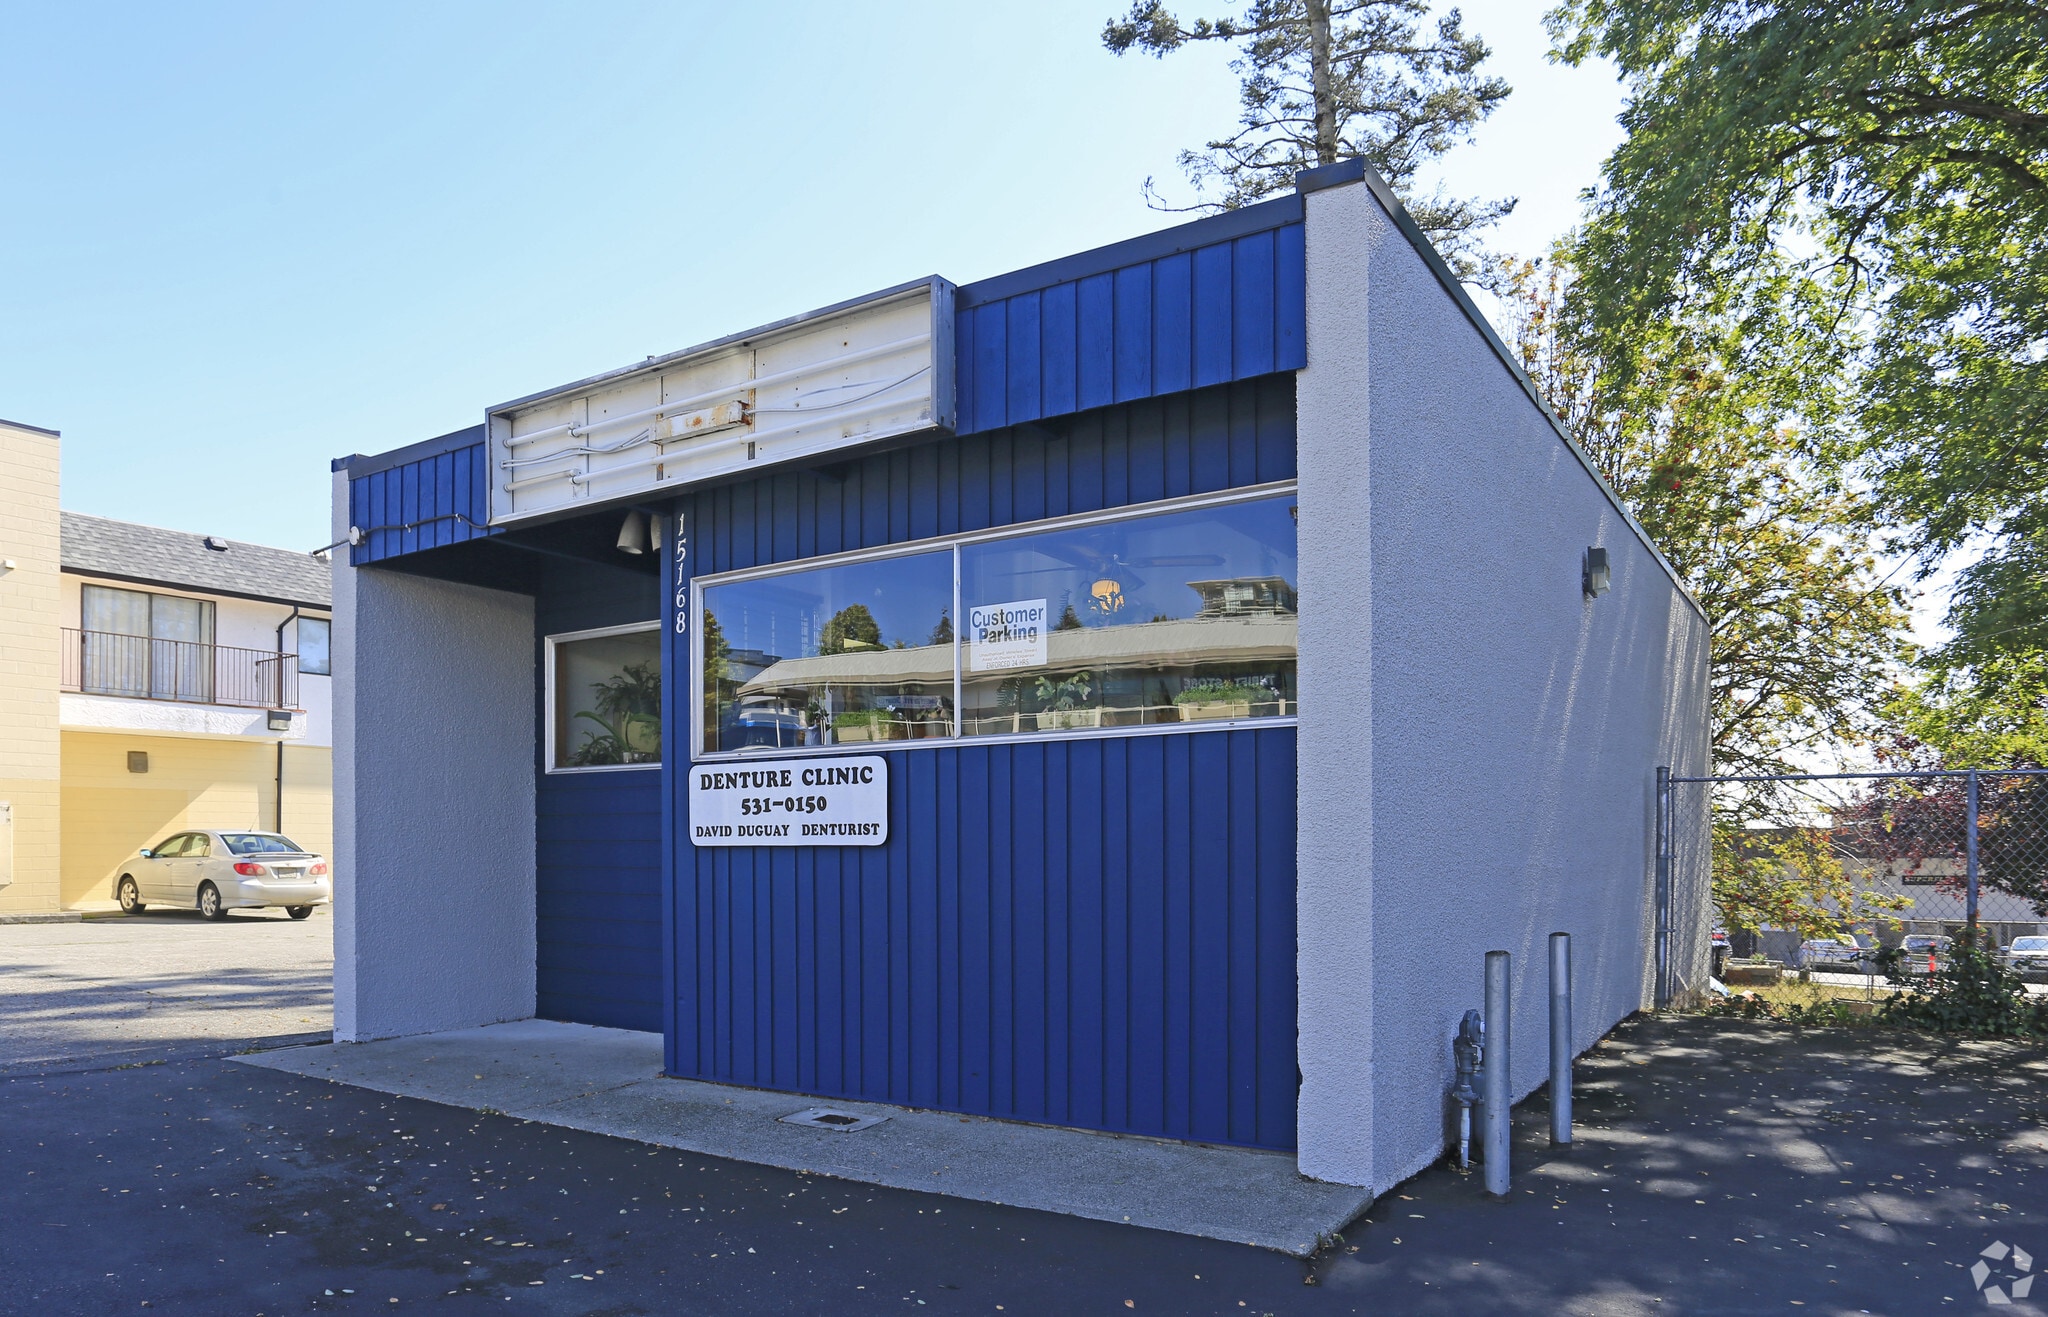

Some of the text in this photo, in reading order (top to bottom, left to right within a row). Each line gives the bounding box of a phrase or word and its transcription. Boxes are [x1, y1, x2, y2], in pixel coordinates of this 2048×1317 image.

[675, 513, 687, 634] 15168
[972, 608, 1043, 628] Customer
[979, 625, 1037, 644] Parking
[700, 766, 873, 790] DENTURE CLINIC
[741, 796, 827, 815] 531-0150
[696, 823, 880, 837] DAVID DUGUAY DENTURIST
